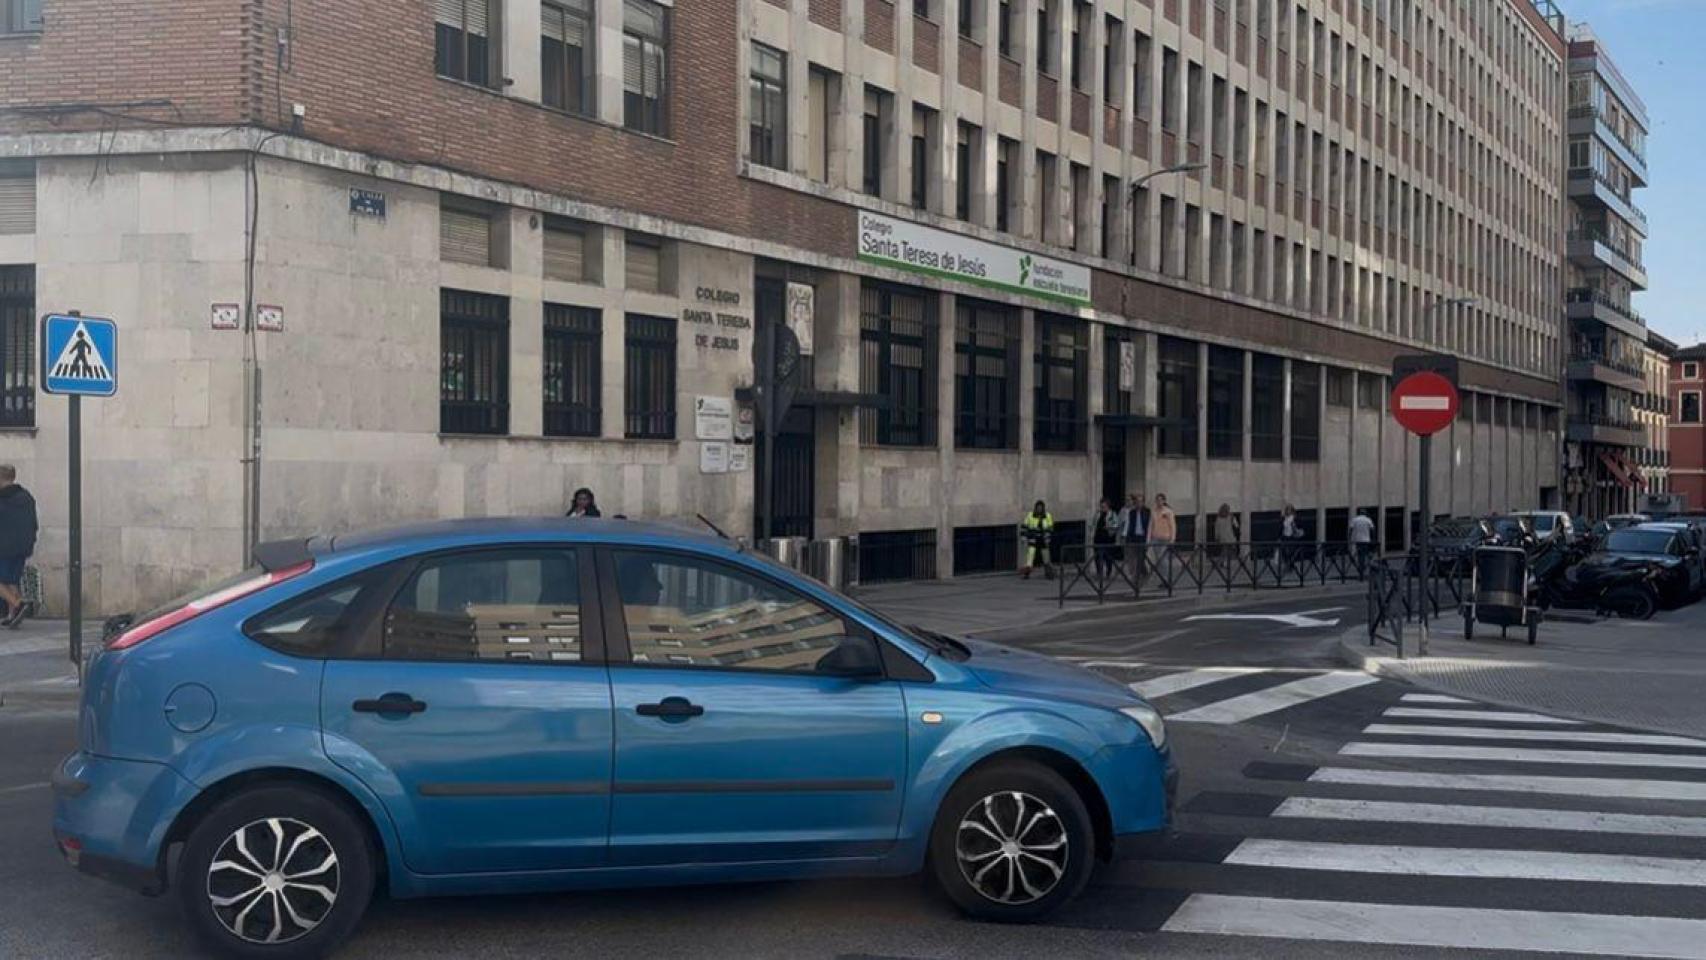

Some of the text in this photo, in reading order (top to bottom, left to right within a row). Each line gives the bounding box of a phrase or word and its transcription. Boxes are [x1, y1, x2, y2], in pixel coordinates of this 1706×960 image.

[862, 215, 893, 236] Colegio
[862, 232, 986, 277] Santa Teresa de Jesús
[696, 286, 740, 304] COLEGIO
[683, 308, 752, 329] SANTA TERESA
[695, 334, 708, 348] DE
